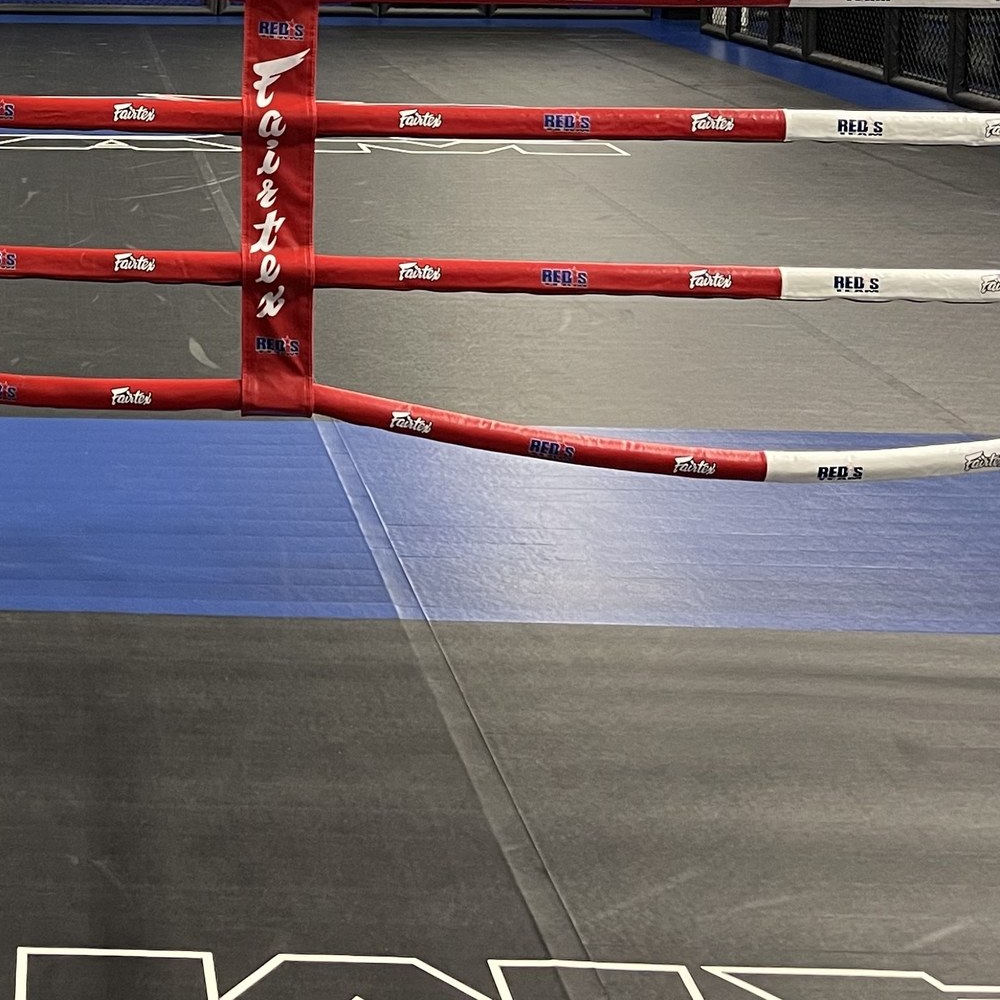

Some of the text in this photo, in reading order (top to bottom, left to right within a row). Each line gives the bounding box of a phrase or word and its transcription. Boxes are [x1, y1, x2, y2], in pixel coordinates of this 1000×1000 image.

[113, 103, 155, 122] Fairtex
[399, 109, 442, 128] Fairtex
[691, 113, 734, 132] Fairtex
[250, 47, 311, 318] Fairtex
[114, 253, 156, 272] Fairtex
[398, 262, 441, 281] Fairtex
[689, 270, 732, 289] Fairtex
[111, 386, 152, 406] Fairtex
[389, 411, 432, 434] Fairtex
[673, 456, 718, 476] Fairtex
